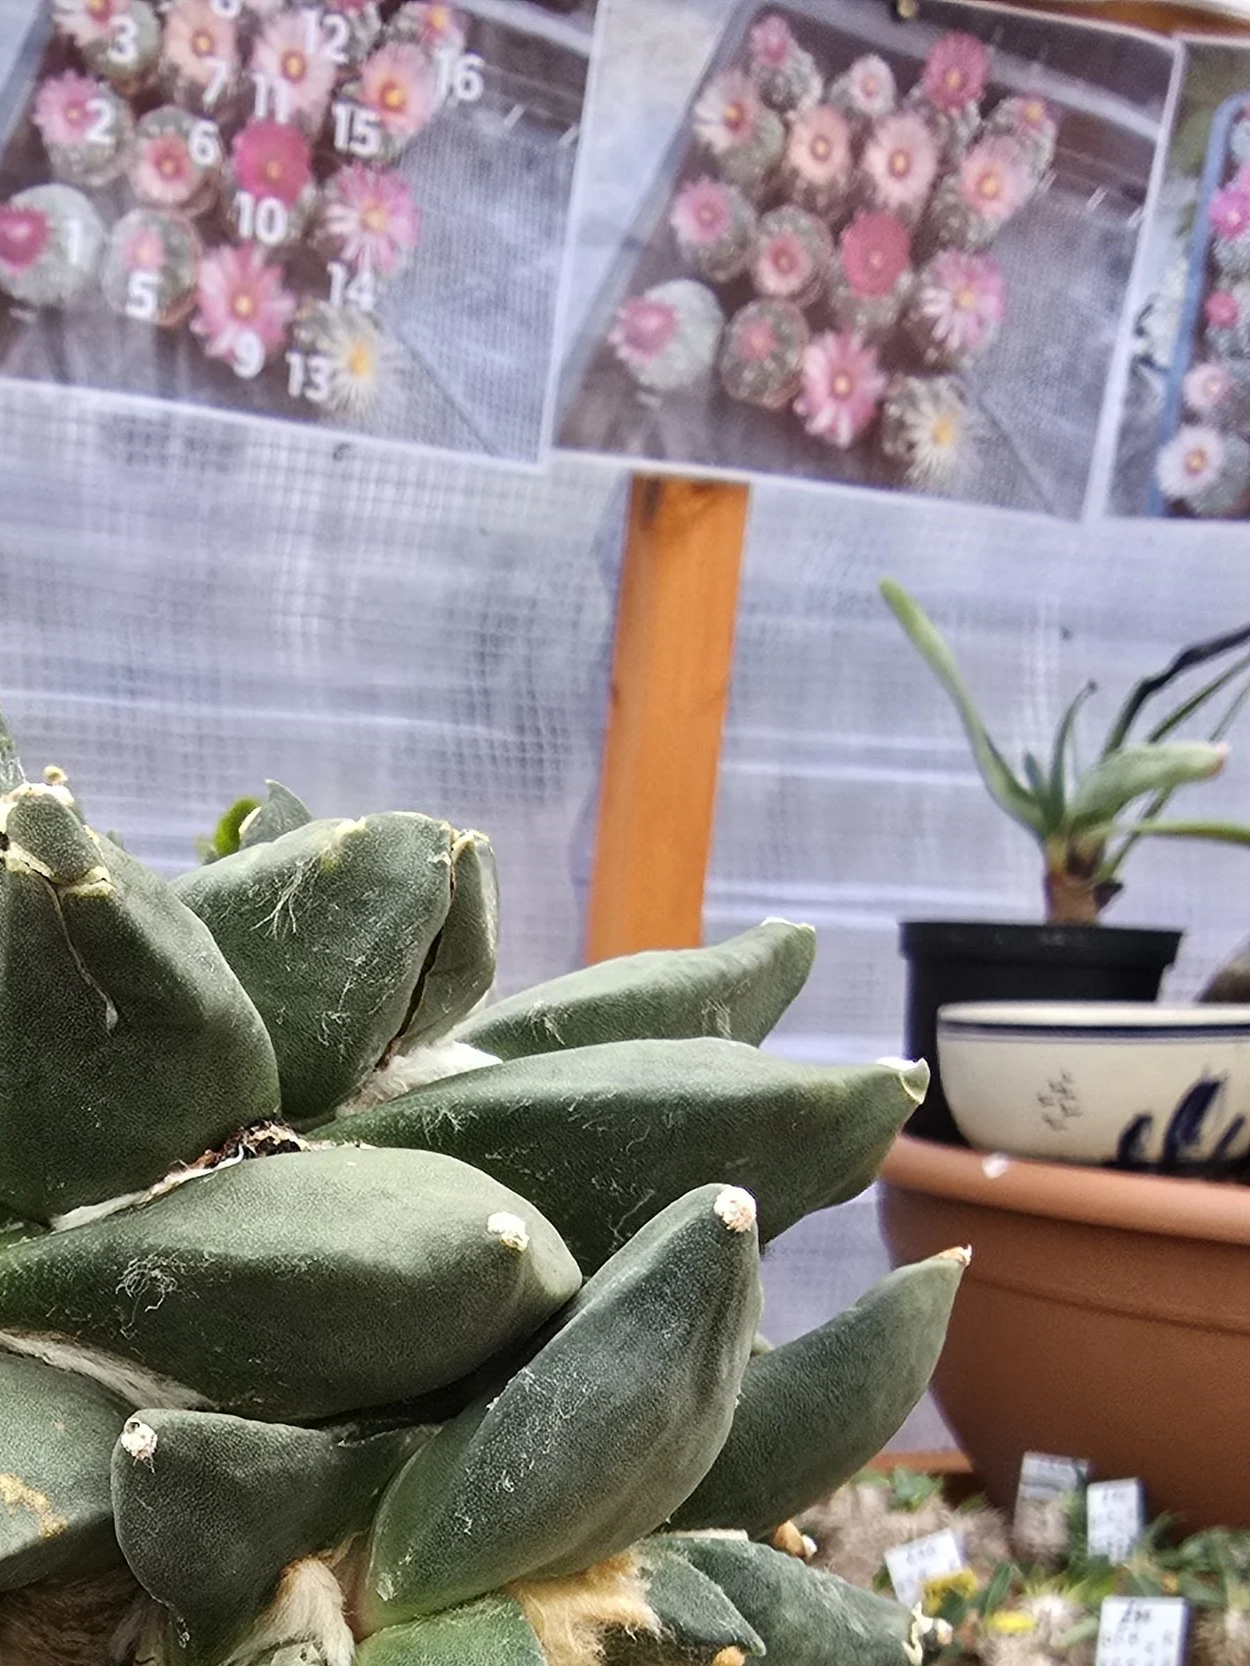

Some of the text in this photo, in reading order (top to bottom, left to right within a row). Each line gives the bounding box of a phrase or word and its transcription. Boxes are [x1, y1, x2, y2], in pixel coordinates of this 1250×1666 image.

[107, 15, 138, 63] 3
[303, 9, 349, 65] 12
[202, 57, 228, 104] 7
[252, 73, 291, 125] 11
[435, 48, 485, 101] 16
[85, 100, 116, 144] 2
[188, 120, 220, 165] 6
[332, 102, 383, 157] 15
[65, 218, 82, 266] 1
[234, 190, 288, 245] 10
[126, 271, 159, 321] 5
[327, 261, 376, 312] 14
[233, 331, 266, 379] 9
[285, 350, 334, 402] 13
